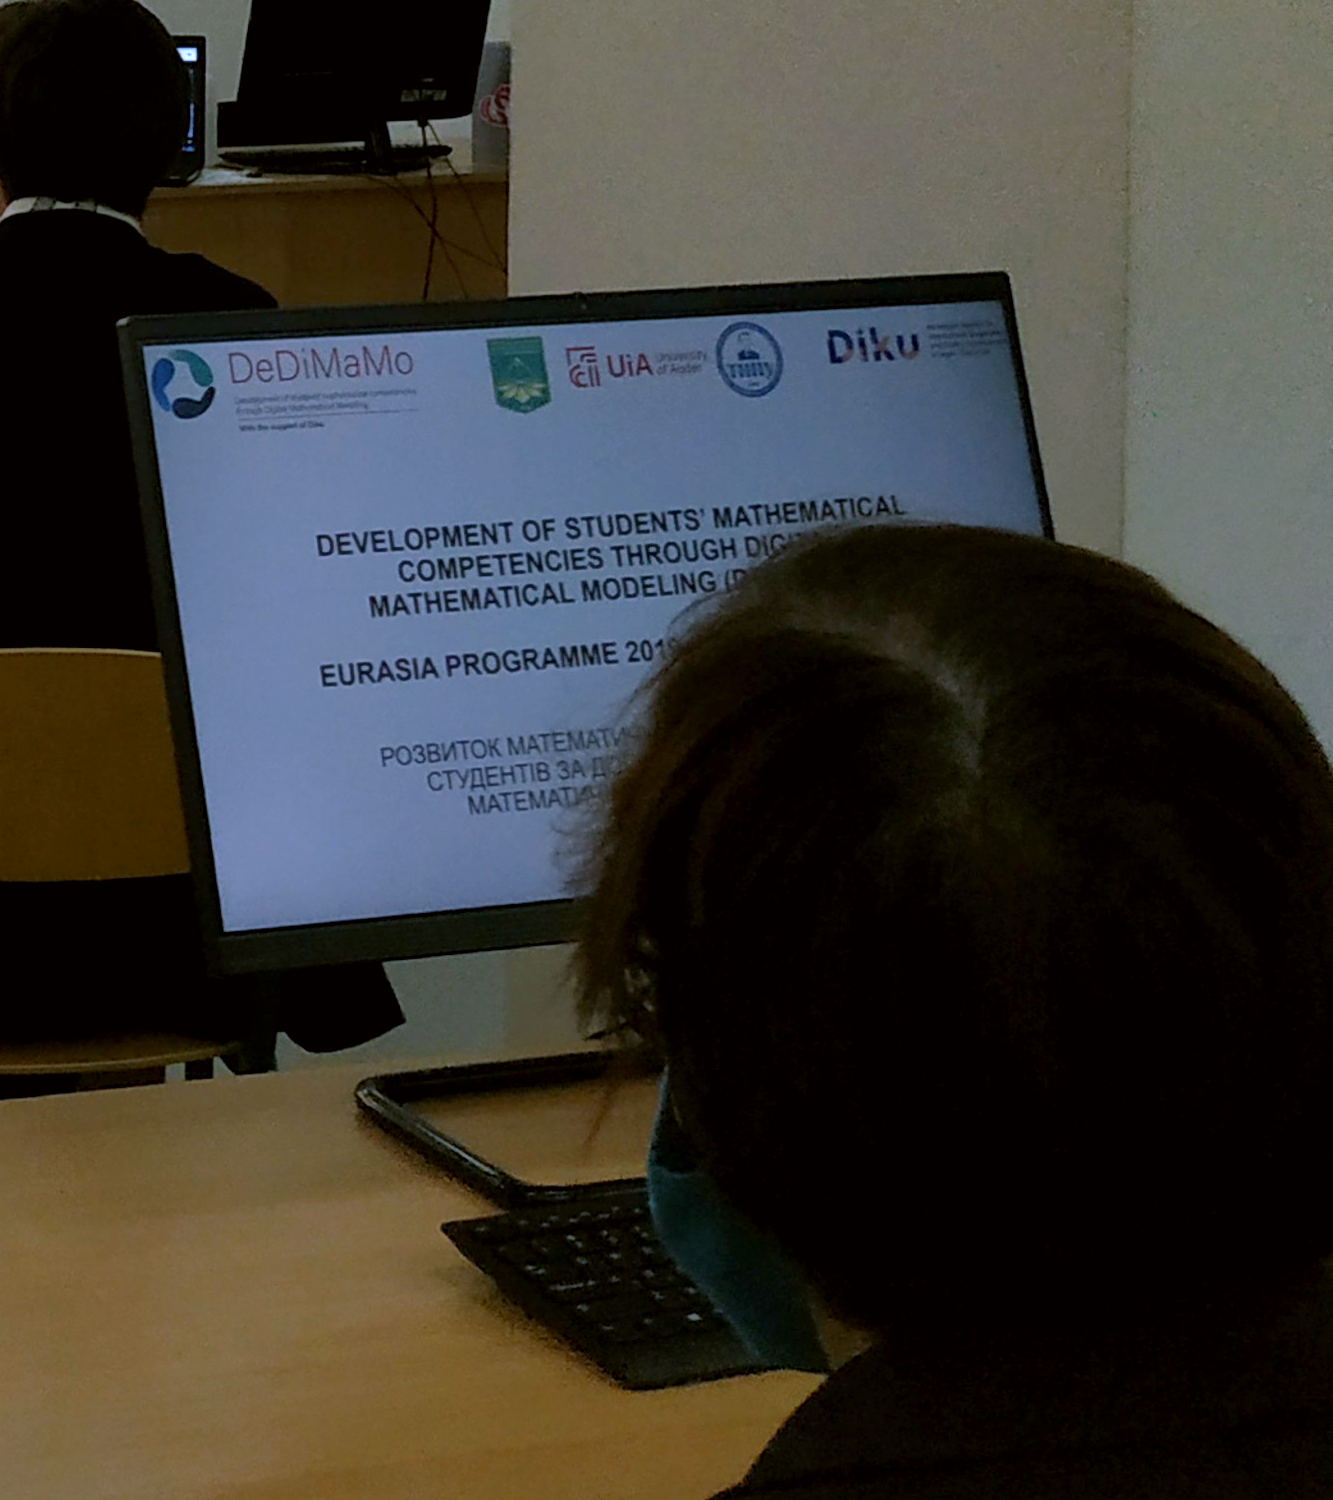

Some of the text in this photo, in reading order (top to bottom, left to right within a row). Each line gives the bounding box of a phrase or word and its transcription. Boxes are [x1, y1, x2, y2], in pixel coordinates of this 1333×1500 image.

[228, 344, 415, 384] DeDiMaMo
[827, 326, 919, 364] Diku
[606, 354, 653, 378] UiA
[316, 494, 908, 556] DEVELOPMENT OF STUDENTS' MATHEMATICAL
[398, 547, 604, 583] COMPETENCIES
[613, 537, 737, 568] THROUGH
[369, 582, 575, 618] MATHEMATICAL
[582, 570, 717, 602] MODELING
[319, 657, 439, 688] EURASIA
[445, 642, 619, 678] PROGRAMME
[379, 738, 501, 767] РОЗВИТОК
[427, 762, 551, 792] СТУДЕНТІВ
[557, 760, 586, 780] ЗА
